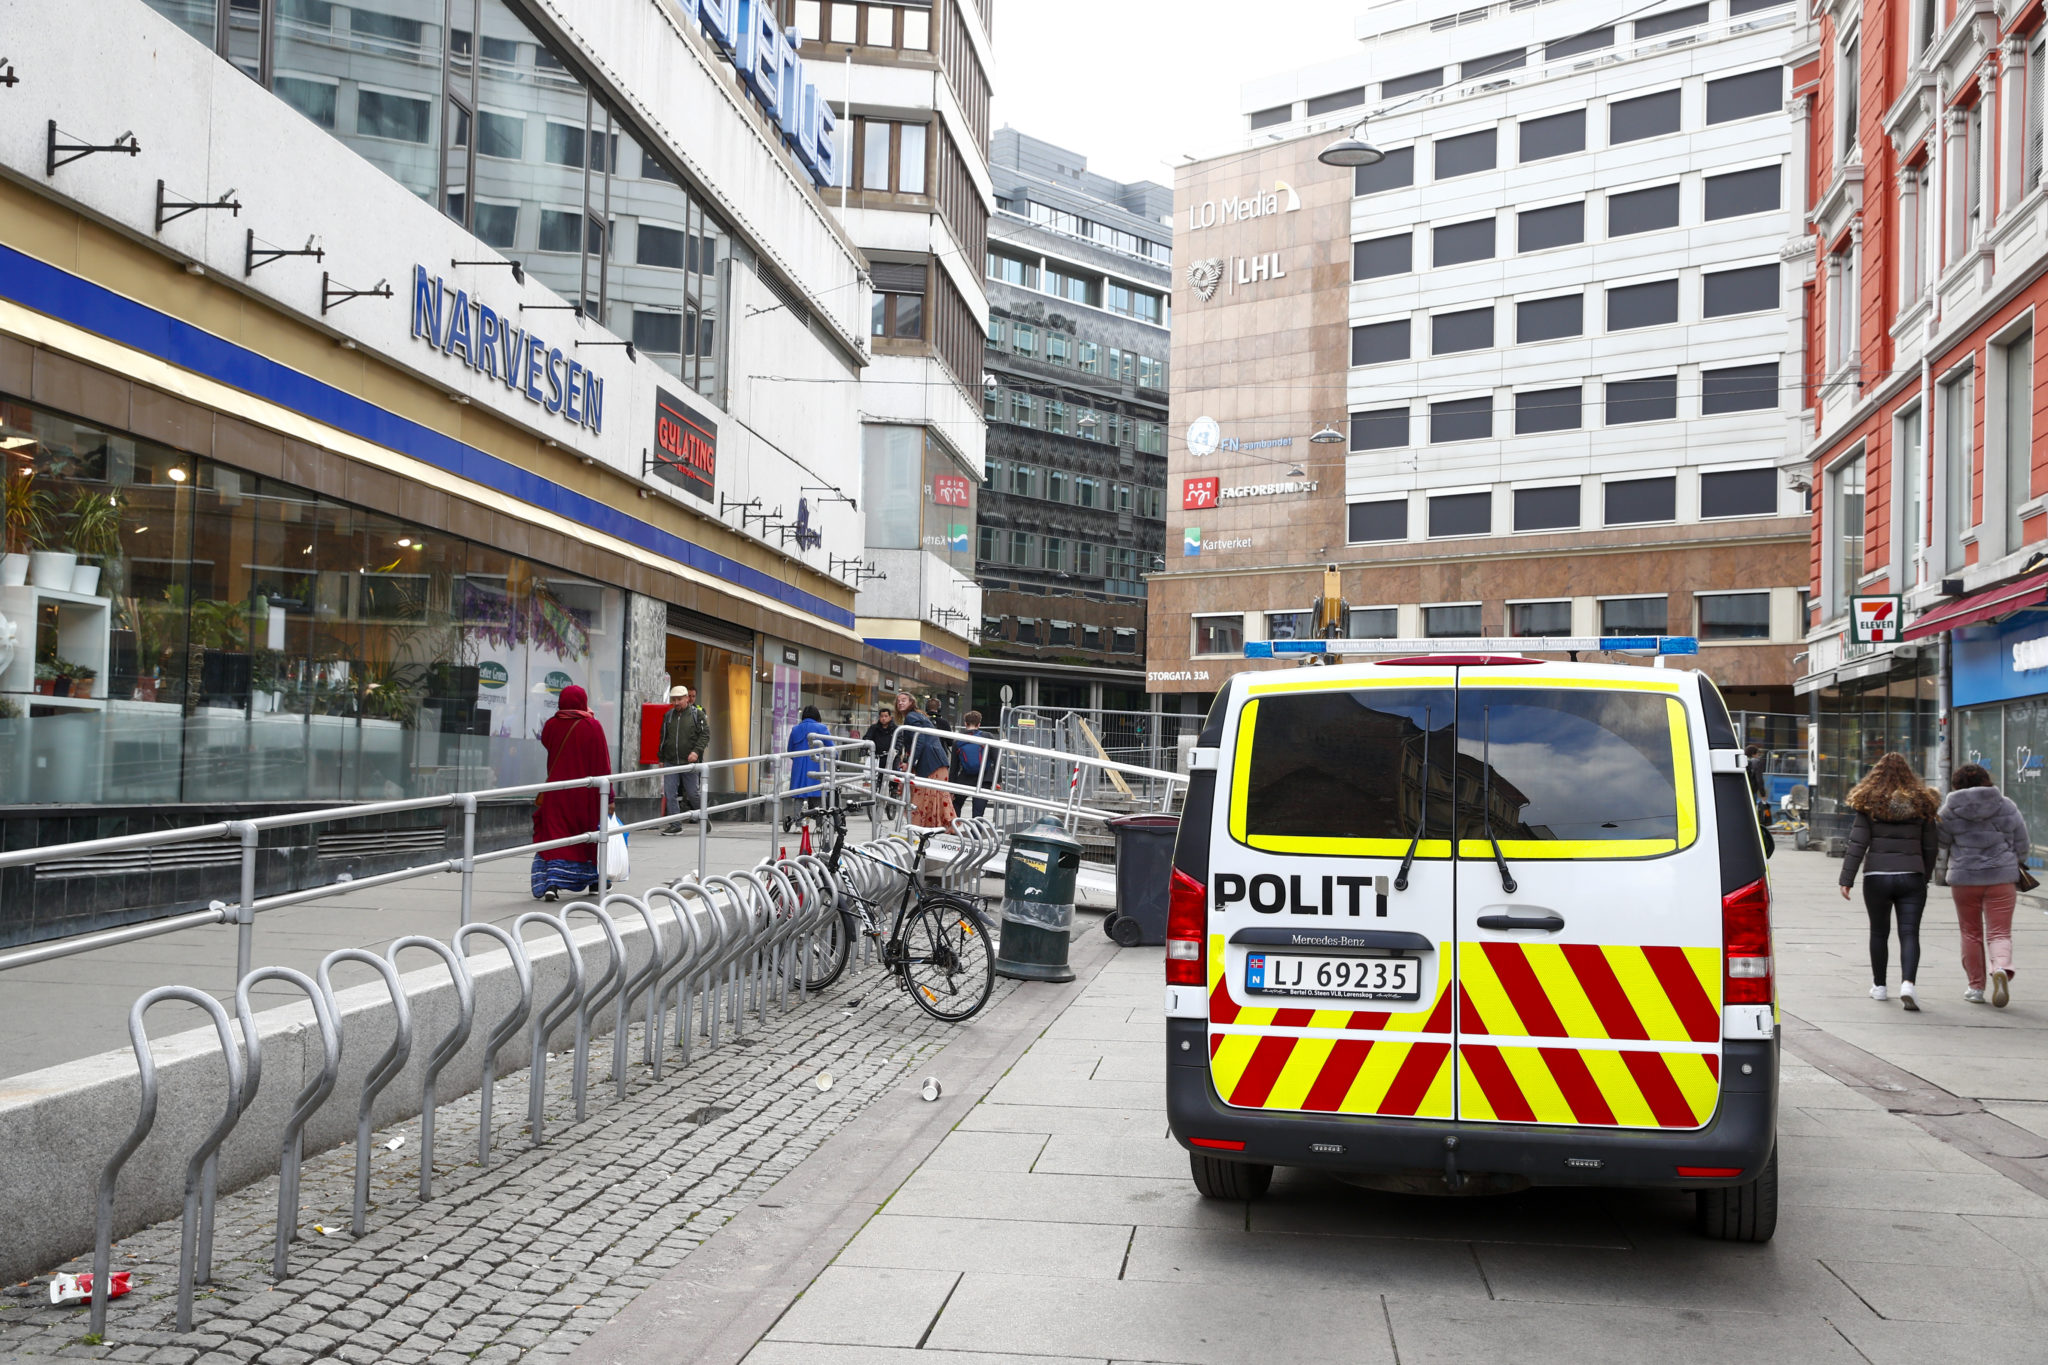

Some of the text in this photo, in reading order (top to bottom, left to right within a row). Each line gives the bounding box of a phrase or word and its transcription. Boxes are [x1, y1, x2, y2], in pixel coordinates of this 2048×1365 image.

[1189, 189, 1278, 230] LO Media
[1238, 253, 1286, 284] LHL
[413, 263, 604, 435] NARVESEN
[1220, 480, 1319, 499] FAGFORBUNDET
[1202, 537, 1252, 551] Kartverket
[1148, 671, 1210, 681] STORGATA 33A
[1291, 934, 1365, 947] Mercedes-Benz
[1252, 976, 1261, 984] N
[1275, 960, 1407, 990] LJ 69235
[1289, 988, 1307, 996] Bertel
